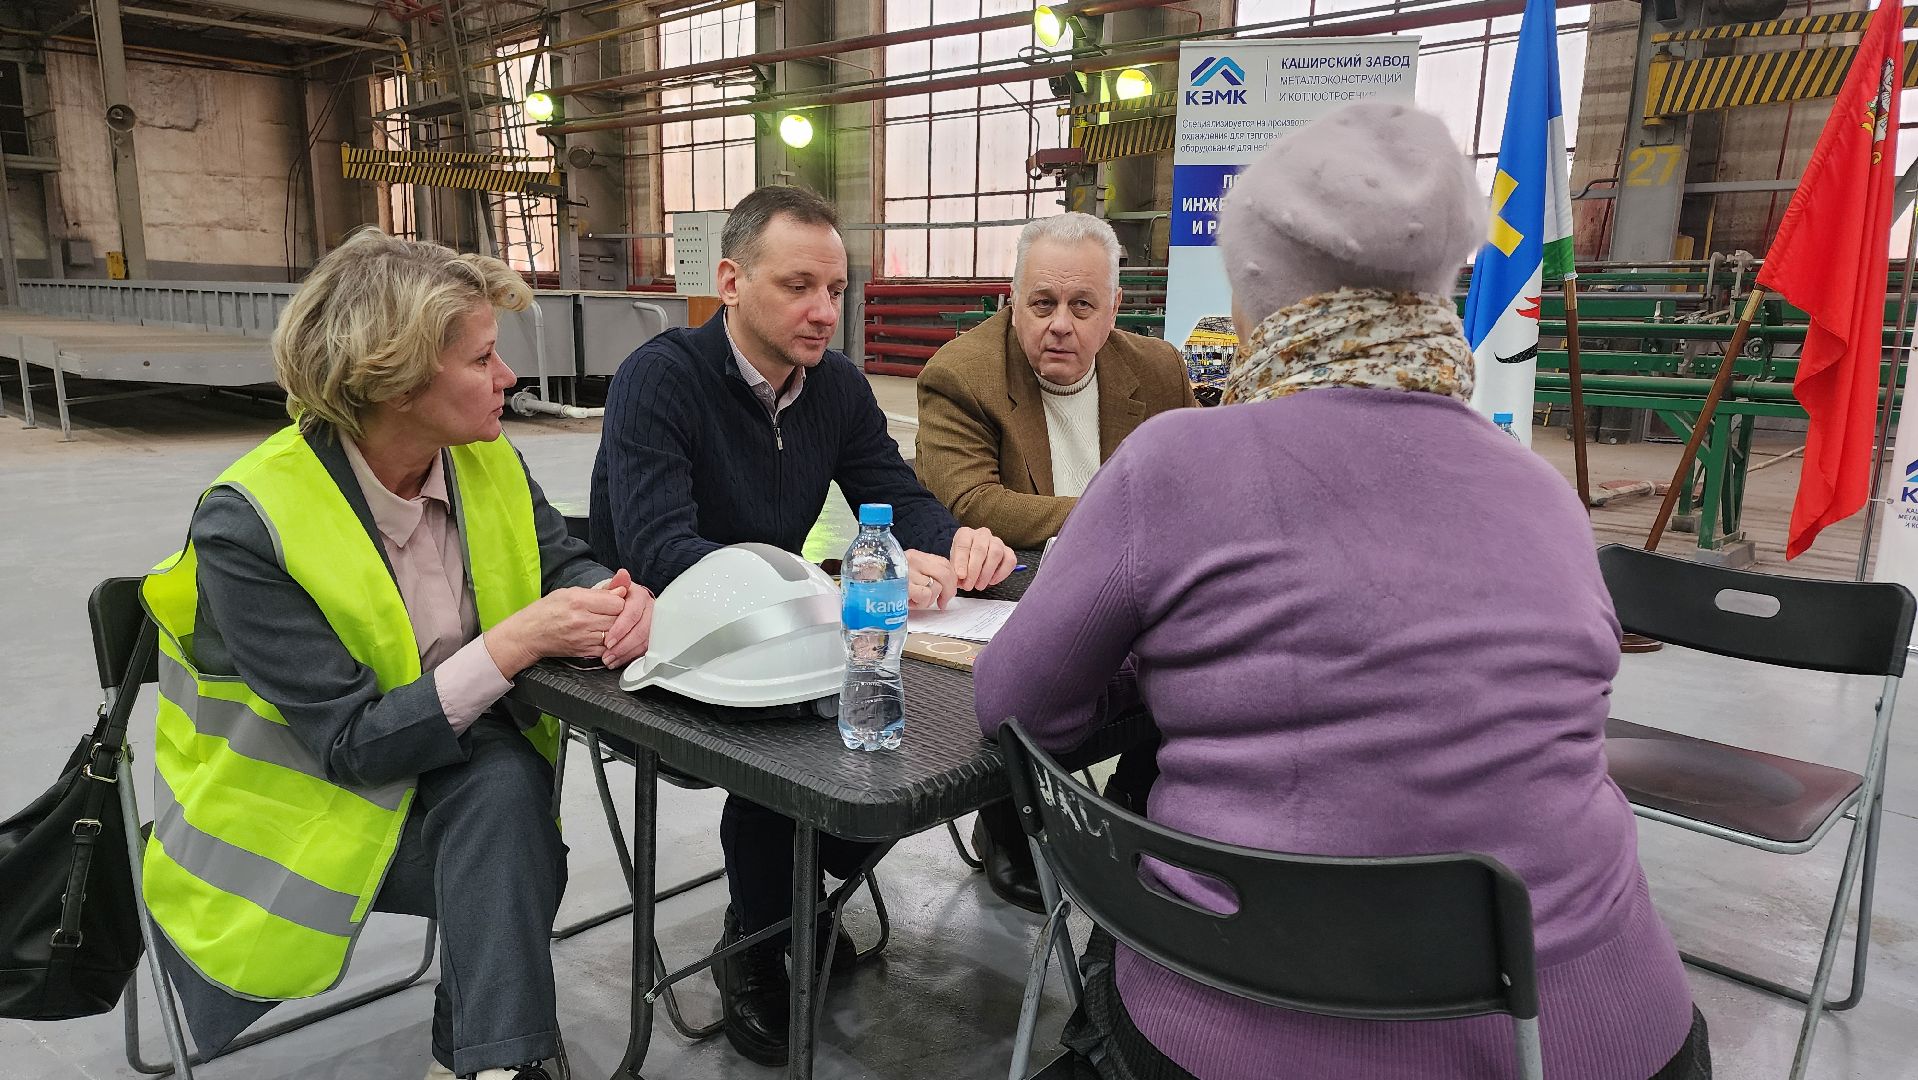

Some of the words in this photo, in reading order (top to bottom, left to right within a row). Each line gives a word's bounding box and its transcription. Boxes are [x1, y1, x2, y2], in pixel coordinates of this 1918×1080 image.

[1281, 53, 1362, 70] КАШИРСКИЙ
[1365, 55, 1411, 69] ЗАВОД
[1185, 89, 1248, 106] КЗМК
[1279, 92, 1287, 102] И
[1182, 119, 1255, 130] Специализируется
[1256, 119, 1267, 128] на
[1181, 132, 1228, 141] охлаждения
[1229, 132, 1245, 141] для
[1236, 144, 1252, 153] для
[1627, 144, 1682, 187] 27
[1191, 220, 1203, 235] И
